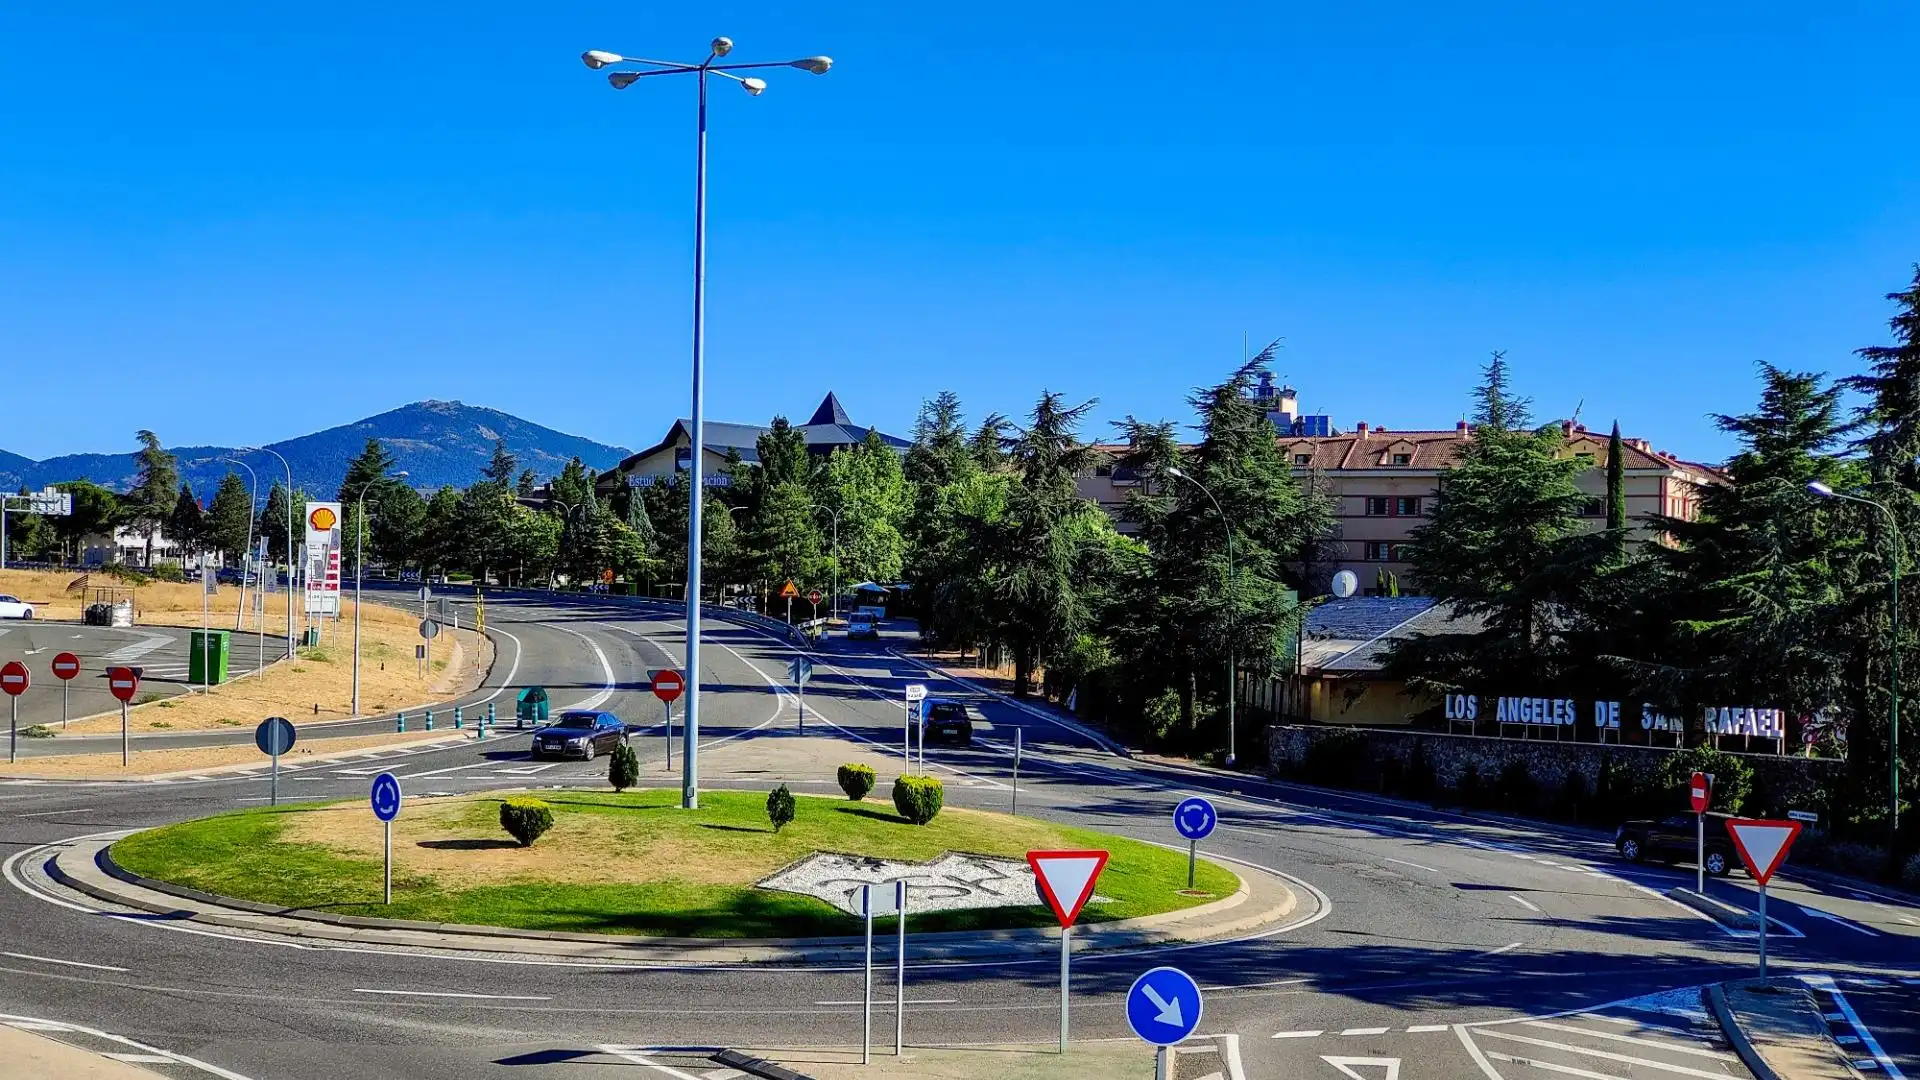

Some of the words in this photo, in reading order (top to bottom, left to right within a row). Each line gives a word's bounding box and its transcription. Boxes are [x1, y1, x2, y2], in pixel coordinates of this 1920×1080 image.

[1445, 693, 1477, 719] LOS
[1495, 696, 1575, 725] ANGELES
[1594, 700, 1621, 728] DE
[1704, 706, 1784, 737] RAFAEL
